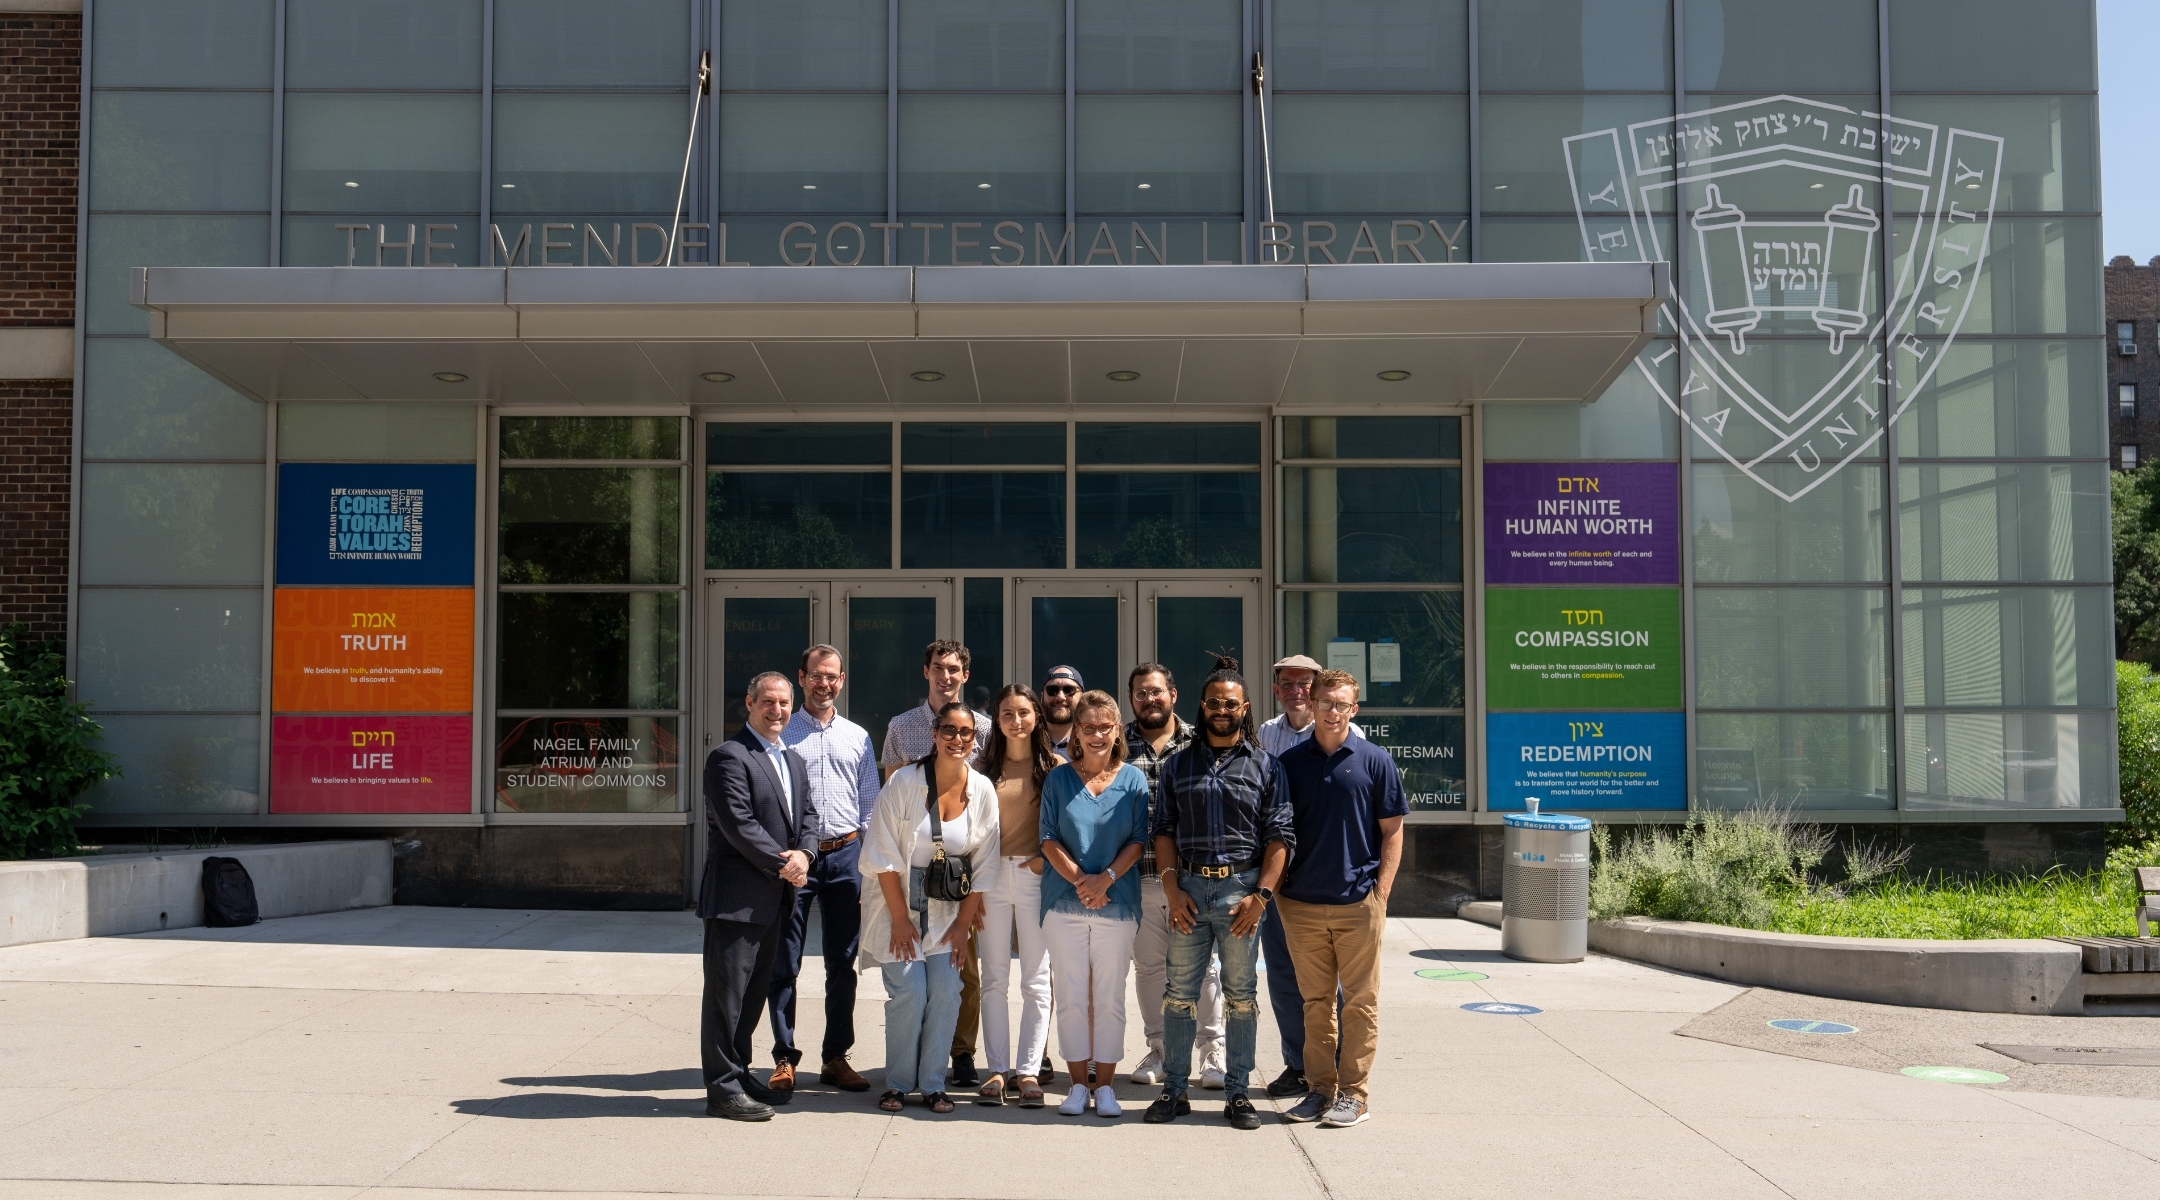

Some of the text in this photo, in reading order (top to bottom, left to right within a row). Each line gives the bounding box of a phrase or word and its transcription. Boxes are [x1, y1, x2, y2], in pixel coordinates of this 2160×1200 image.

[334, 219, 1468, 268] THE MENDEL GOTTESMAN LIBRARY
[1558, 478, 1600, 493] אדם
[339, 496, 390, 514] CORE
[1538, 500, 1621, 515] INFINITE
[339, 515, 404, 532] TORAH
[411, 501, 423, 552] REDEMPTION
[1506, 519, 1653, 534] HUMAN WORTH
[338, 533, 411, 551] VALUES
[352, 613, 396, 628] אמת
[1561, 610, 1603, 625] חסד
[725, 621, 765, 632] ENDEL
[341, 635, 406, 650] TRUTH
[1515, 631, 1649, 647] COMPASSION
[350, 667, 368, 675] truth,
[384, 667, 421, 675] humanity's
[423, 667, 443, 675] ability
[1569, 663, 1614, 671] responsibility
[1582, 672, 1624, 680] compassion.
[1361, 725, 1389, 737] THE
[1569, 722, 1604, 742] ציון
[352, 731, 395, 747] חיים
[534, 738, 641, 750] NAGEL FAMILY
[1380, 746, 1454, 758] TTESMAN
[1521, 746, 1652, 762] REDEMPTION
[352, 753, 394, 769] LIFE
[540, 756, 633, 769] ATRIUM AND
[1703, 761, 1741, 770] Heights
[358, 777, 386, 785] bringing
[507, 774, 666, 787] STUDENT COMMONS
[1580, 771, 1617, 779] humanity's
[1705, 771, 1742, 781] Lounge
[1410, 793, 1461, 804] AVENUE
[1524, 822, 1556, 830] Recycle
